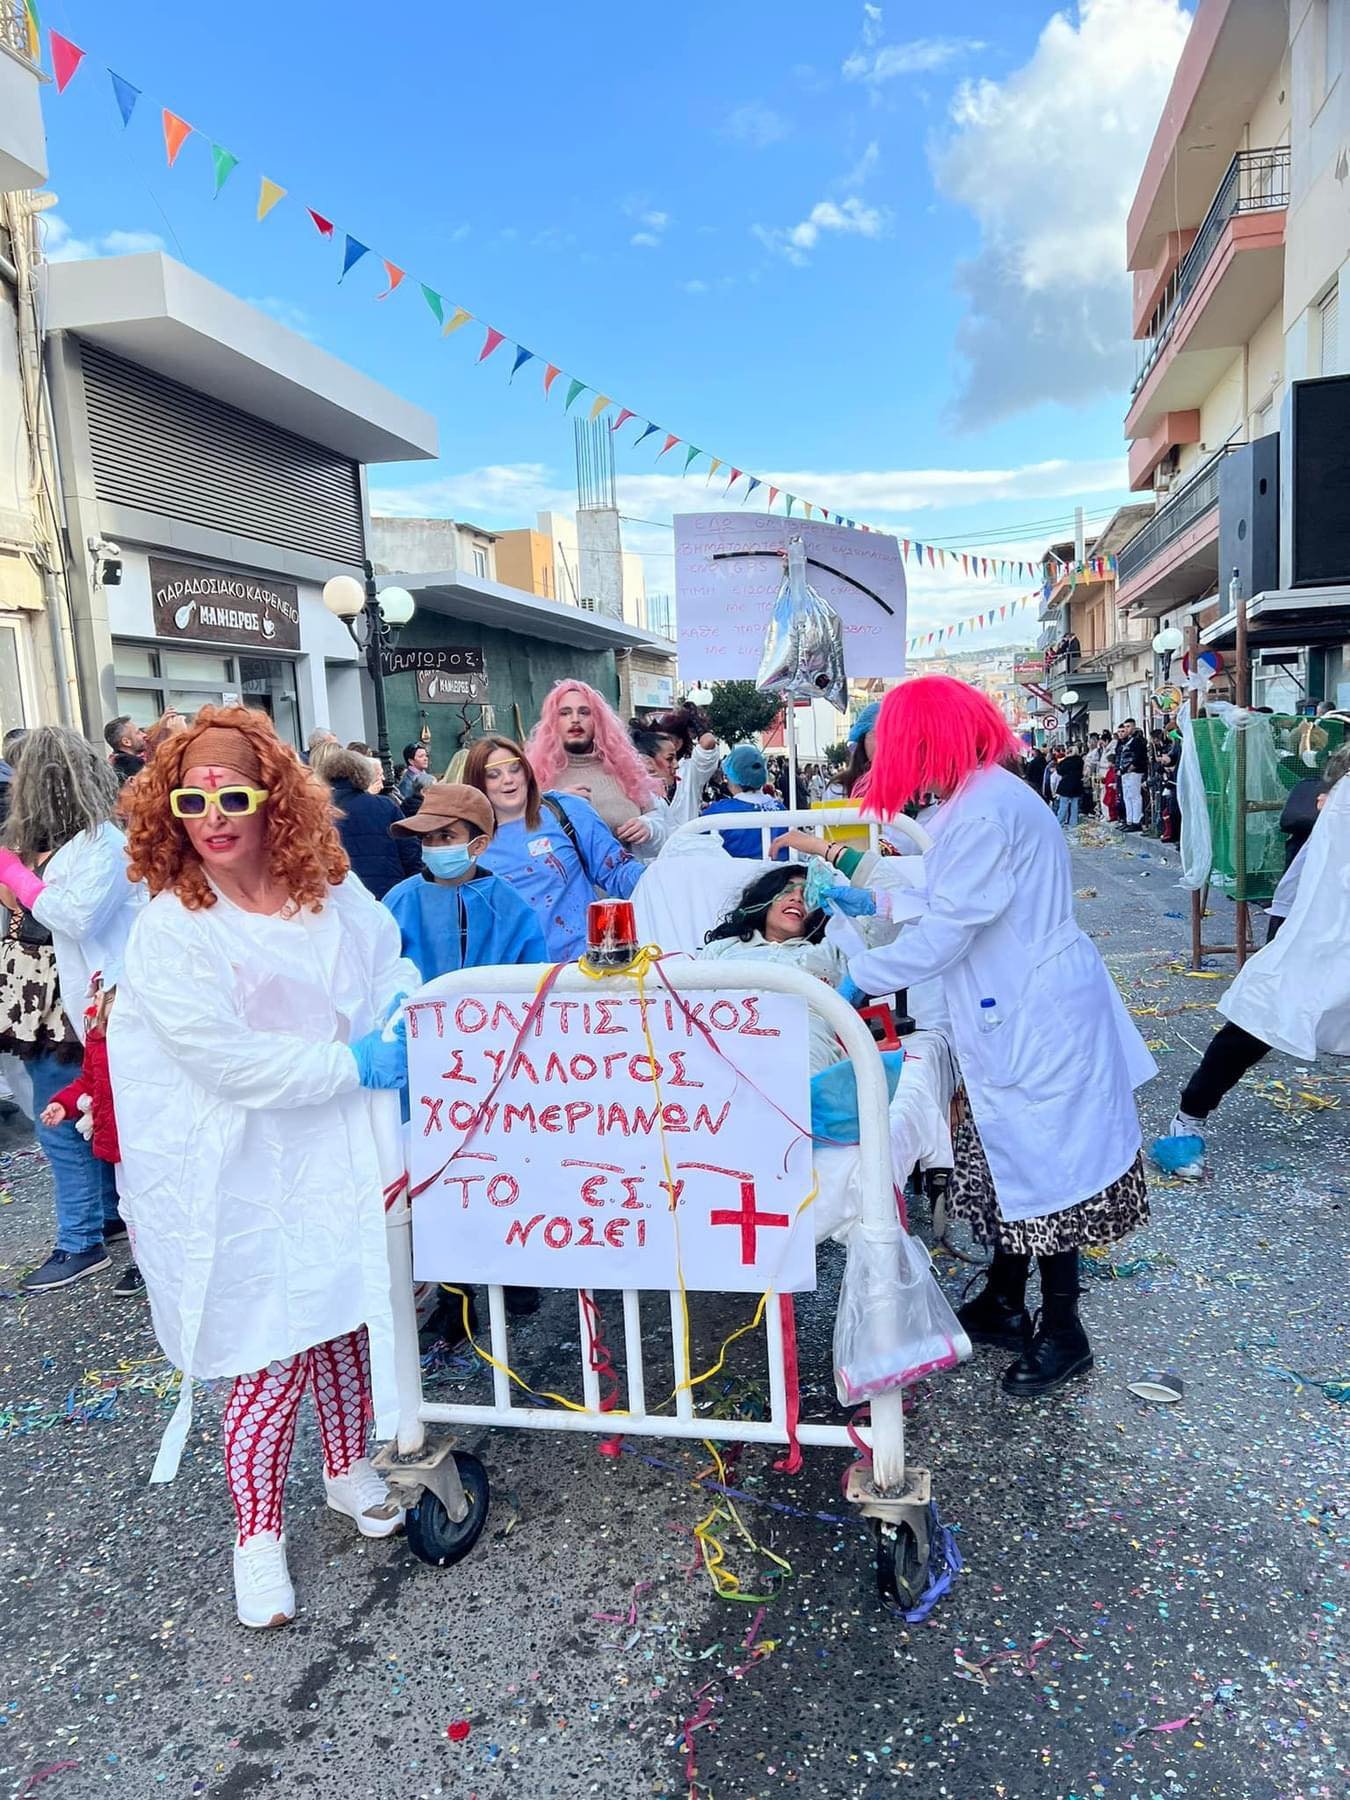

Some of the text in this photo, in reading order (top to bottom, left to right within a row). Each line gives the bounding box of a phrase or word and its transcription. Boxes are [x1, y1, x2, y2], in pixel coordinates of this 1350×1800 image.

[156, 578, 299, 624] ΠΑΡΑΔΟΣΙΑΚΟ ΚΑΦΕΝΕΙΟ
[200, 605, 260, 631] ΜΑΝΙΩΡΟΣ
[405, 996, 781, 1038] ΠΟΛΥΤΙΣΤΙΚΟΣ
[441, 1049, 704, 1088] ΣΥΛΛΟΓΟΣ
[420, 1095, 732, 1137] ΧΟΥΜΕΡΙΑΝΩΝ
[443, 1172, 521, 1209] ΤΟ
[504, 1213, 647, 1249] ΝΟΣΕΙ
